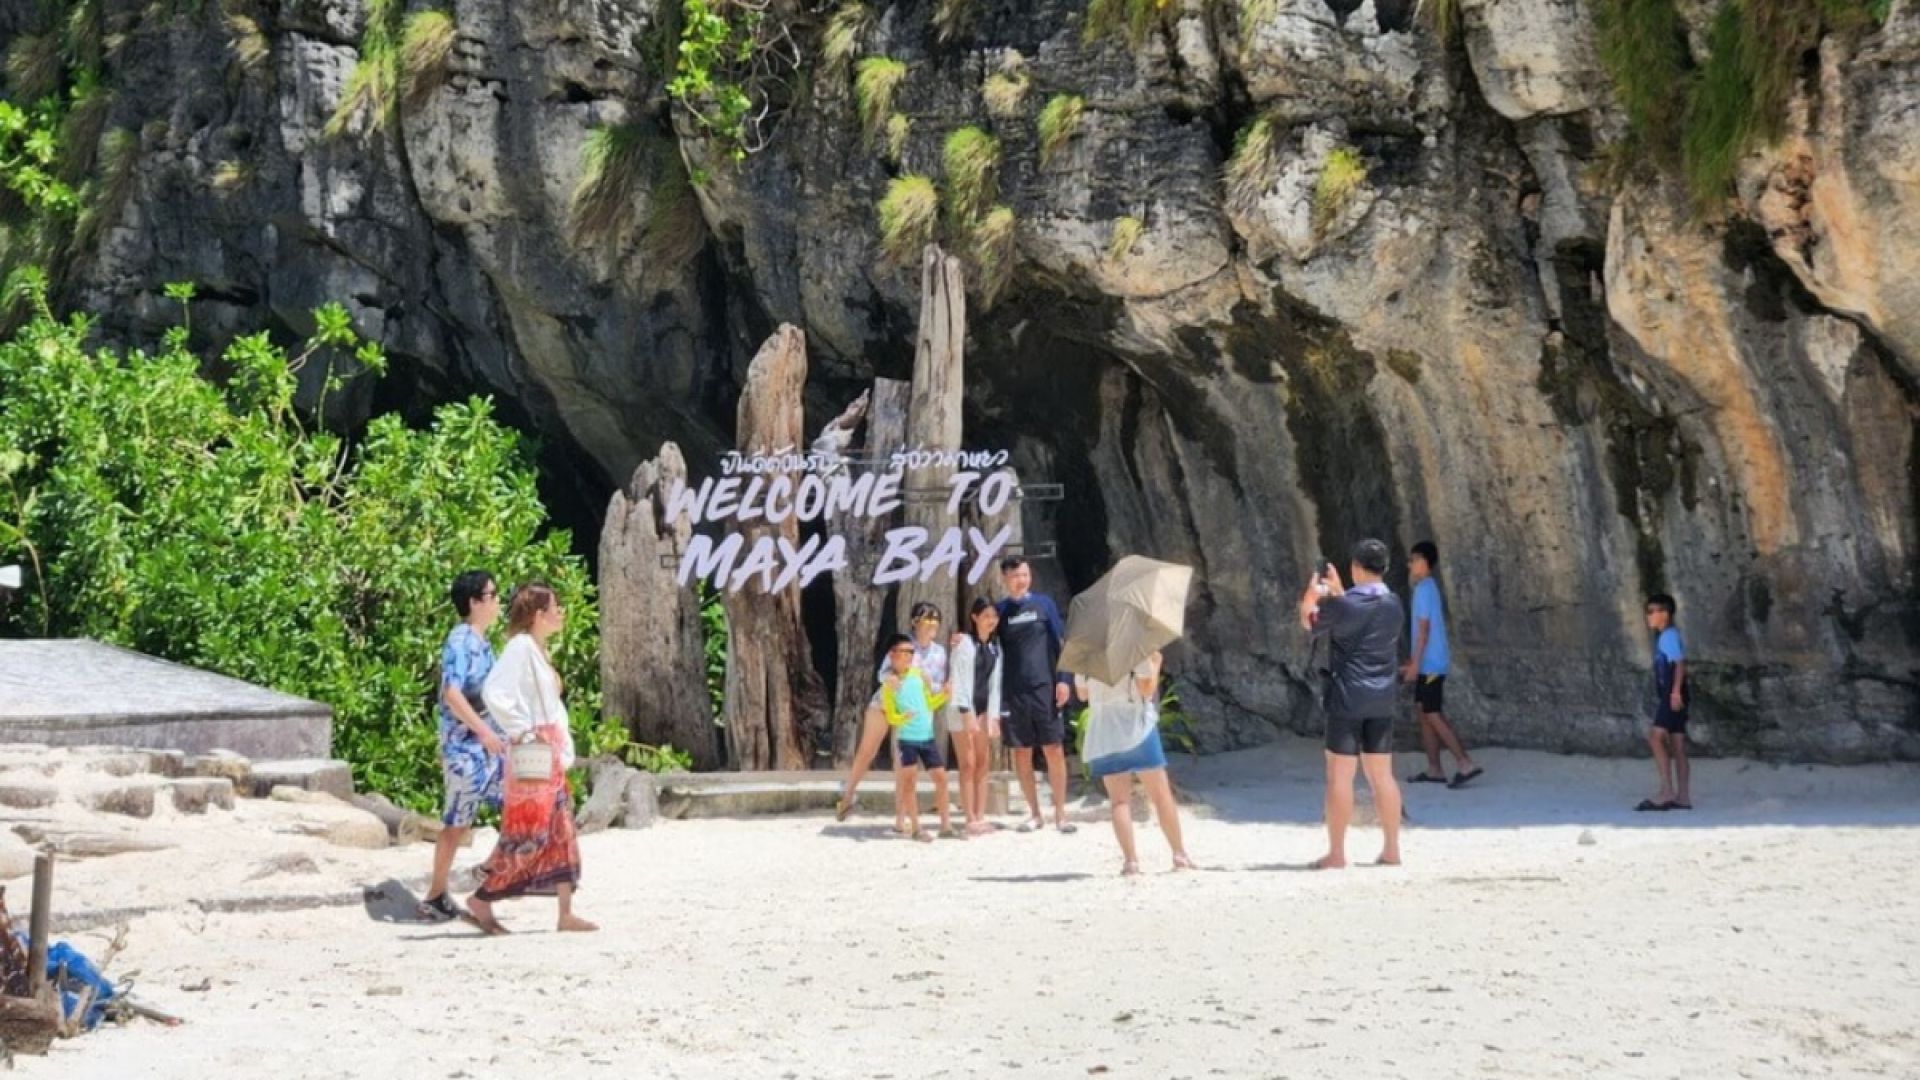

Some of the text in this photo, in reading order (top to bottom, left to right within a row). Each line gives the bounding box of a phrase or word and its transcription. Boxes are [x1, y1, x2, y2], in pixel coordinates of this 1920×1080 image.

[667, 472, 1016, 524] WELCOME TO
[677, 525, 1012, 595] MAYA BAY
